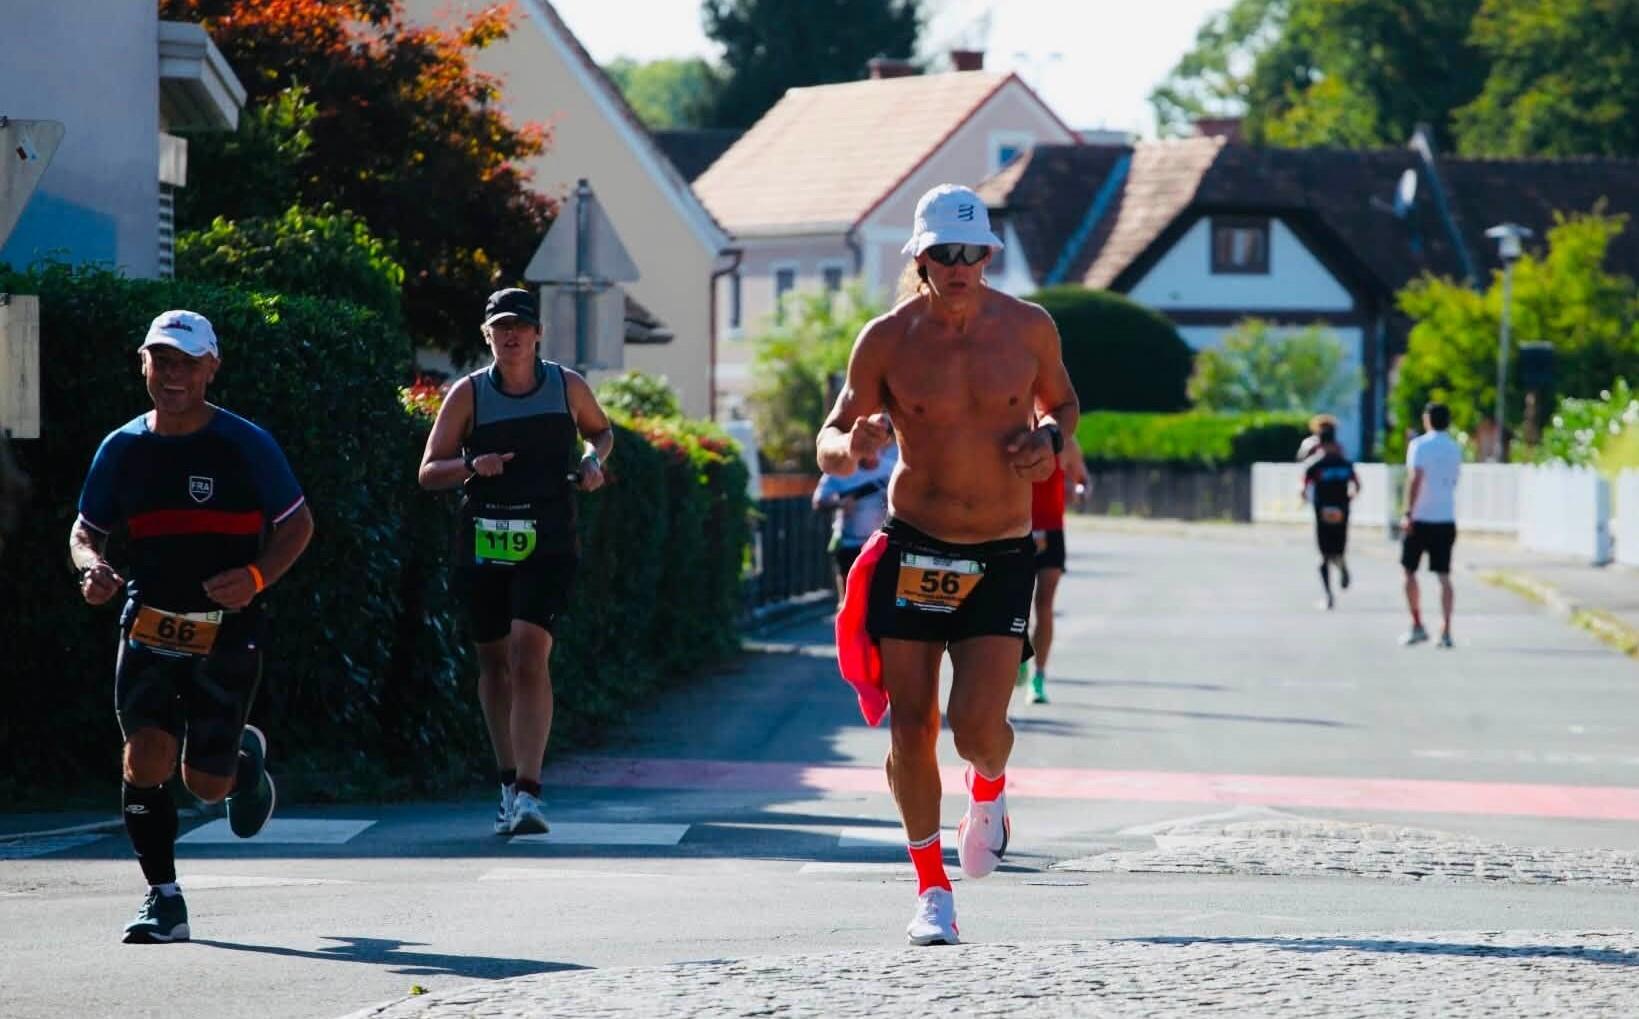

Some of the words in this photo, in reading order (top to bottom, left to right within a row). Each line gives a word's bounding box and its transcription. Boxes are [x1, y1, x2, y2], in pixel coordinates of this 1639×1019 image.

[485, 531, 528, 552] 119
[920, 570, 960, 594] 56
[158, 617, 194, 641] 66
